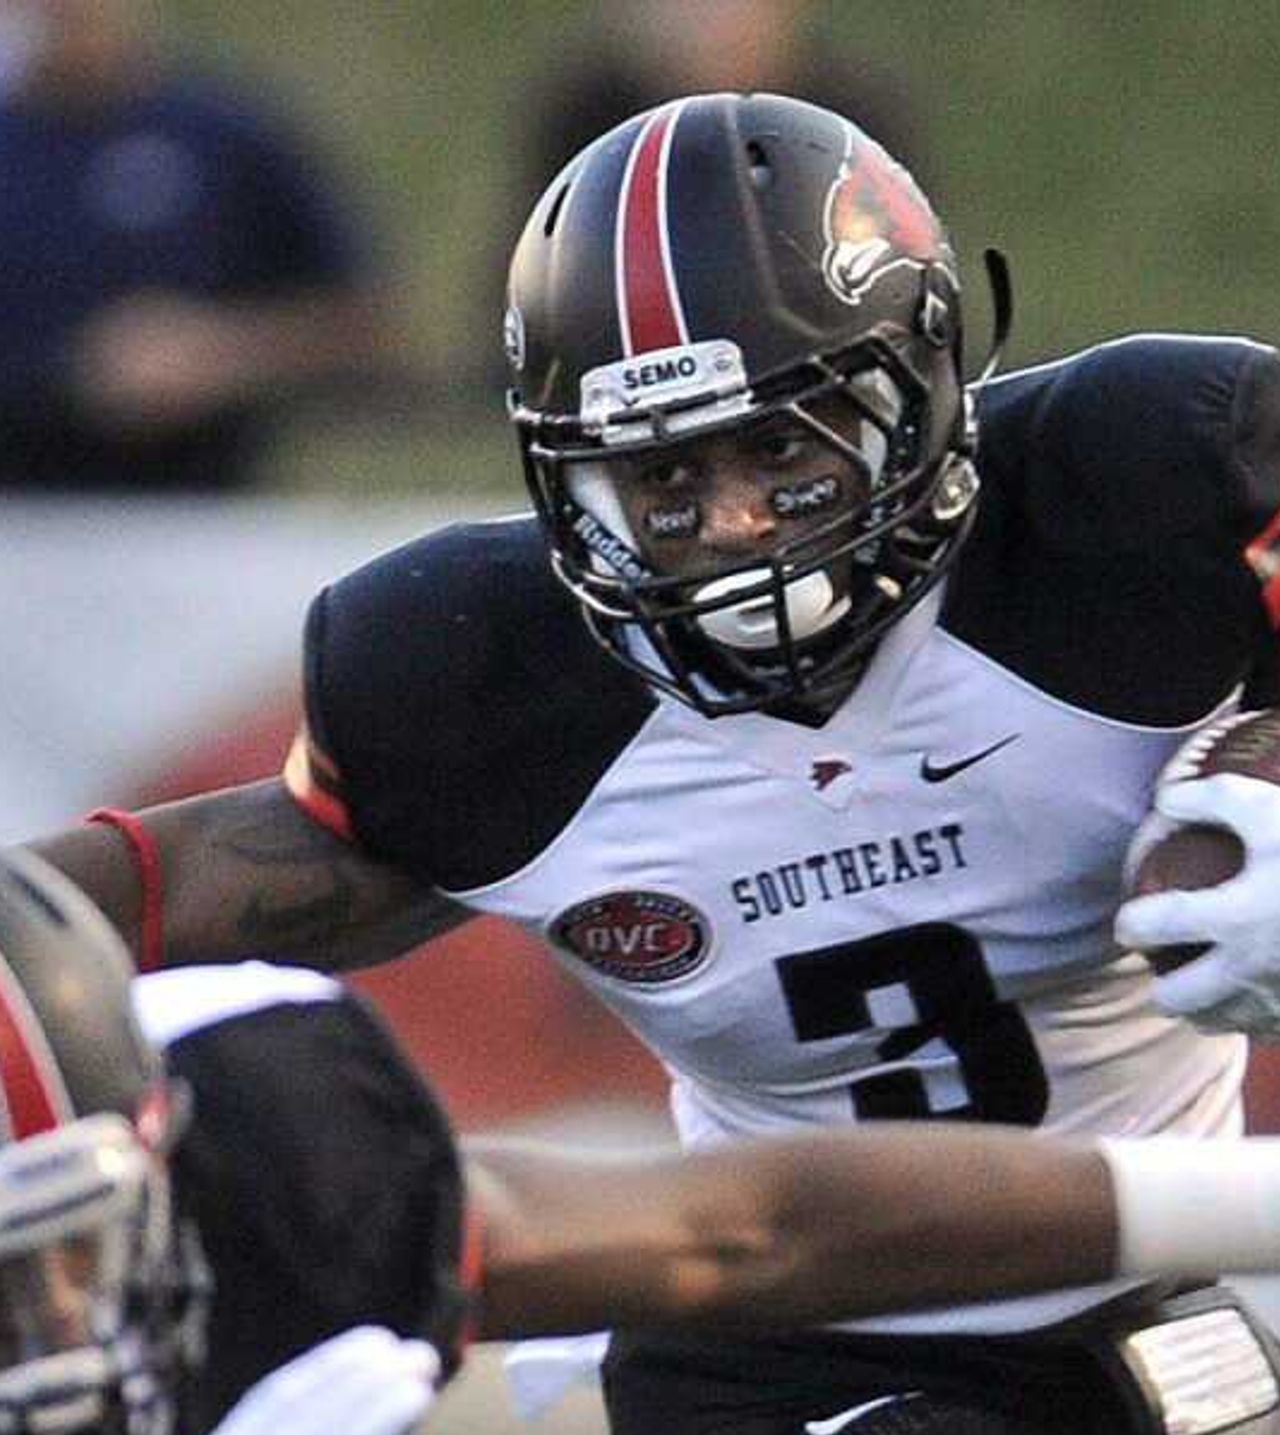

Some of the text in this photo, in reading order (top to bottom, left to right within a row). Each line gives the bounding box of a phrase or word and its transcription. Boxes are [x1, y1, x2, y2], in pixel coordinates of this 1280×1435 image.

[622, 356, 697, 390] SEMO
[730, 821, 968, 923] SOUTHEAST
[775, 920, 1050, 1127] 3
